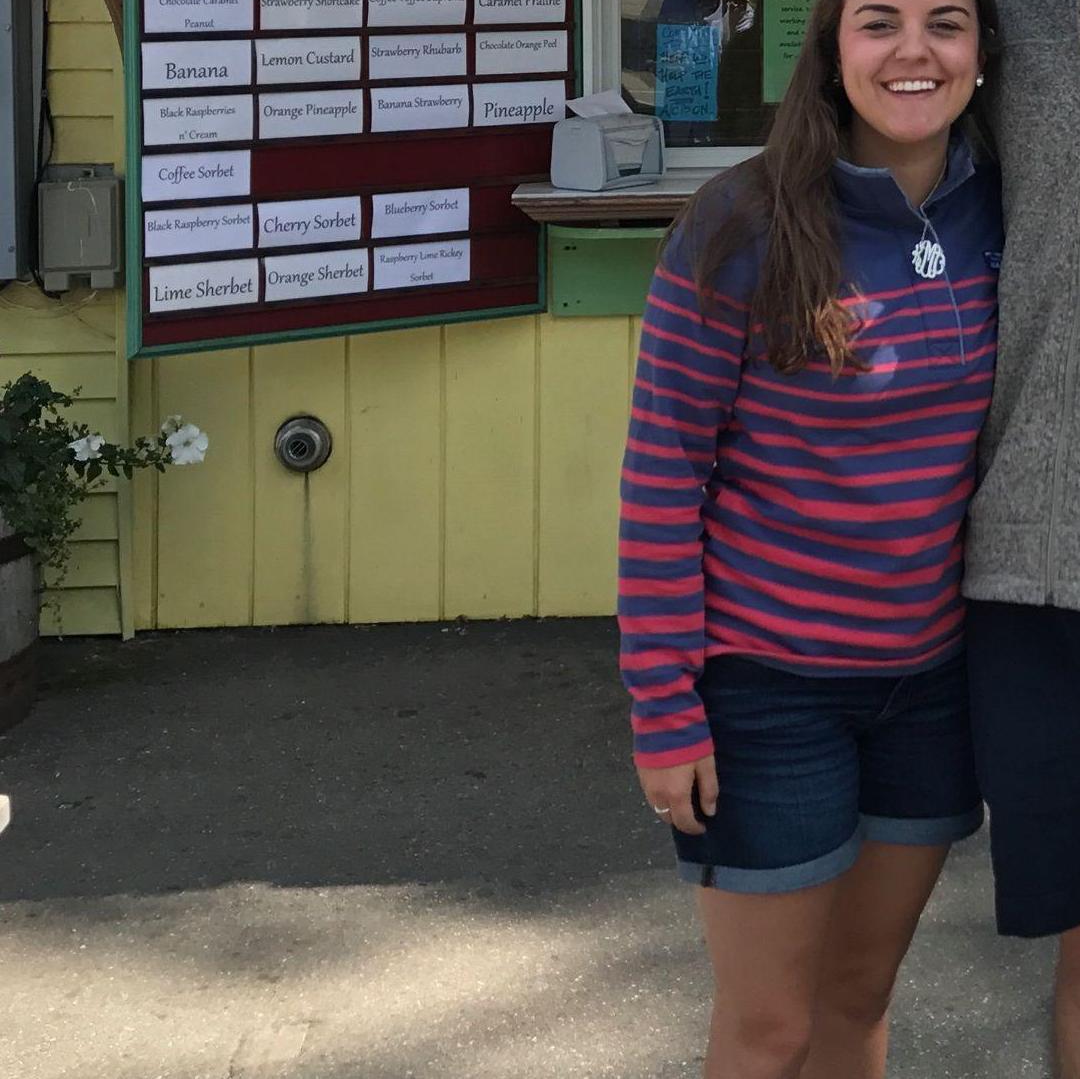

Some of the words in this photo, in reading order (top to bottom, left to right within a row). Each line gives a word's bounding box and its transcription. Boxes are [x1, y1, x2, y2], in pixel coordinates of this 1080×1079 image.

[184, 18, 214, 28] Peanut
[371, 44, 421, 60] Strawberry
[422, 42, 462, 56] Rhubarb
[479, 39, 514, 50] Chocolate
[515, 40, 542, 51] Orange
[543, 39, 558, 49] Peel
[261, 53, 303, 67] Lemon
[306, 49, 355, 65] Custard
[165, 62, 229, 80] Banana
[263, 105, 303, 119] Orange
[306, 101, 357, 118] Pineapple
[377, 98, 412, 110] Banana
[414, 95, 463, 109] Strawberry
[484, 97, 554, 121] Pineapple
[160, 108, 183, 118] Black
[185, 106, 236, 118] Raspberries
[188, 129, 218, 139] Cream
[158, 165, 195, 184] Coffee
[197, 163, 234, 179] Sorbet
[384, 201, 428, 215] Blueberry
[429, 198, 459, 211] Sorbet
[147, 220, 172, 232] Black
[174, 218, 220, 232] Raspberry
[221, 214, 251, 226] Sorbet
[264, 218, 311, 236] Cherry
[314, 211, 356, 230] Sorbet
[380, 253, 418, 265] Raspberry
[268, 270, 315, 287] Orange
[317, 263, 364, 281] Sherbet
[410, 271, 434, 282] Sorbet
[154, 285, 192, 302] Lime
[196, 276, 253, 294] Sherbet
